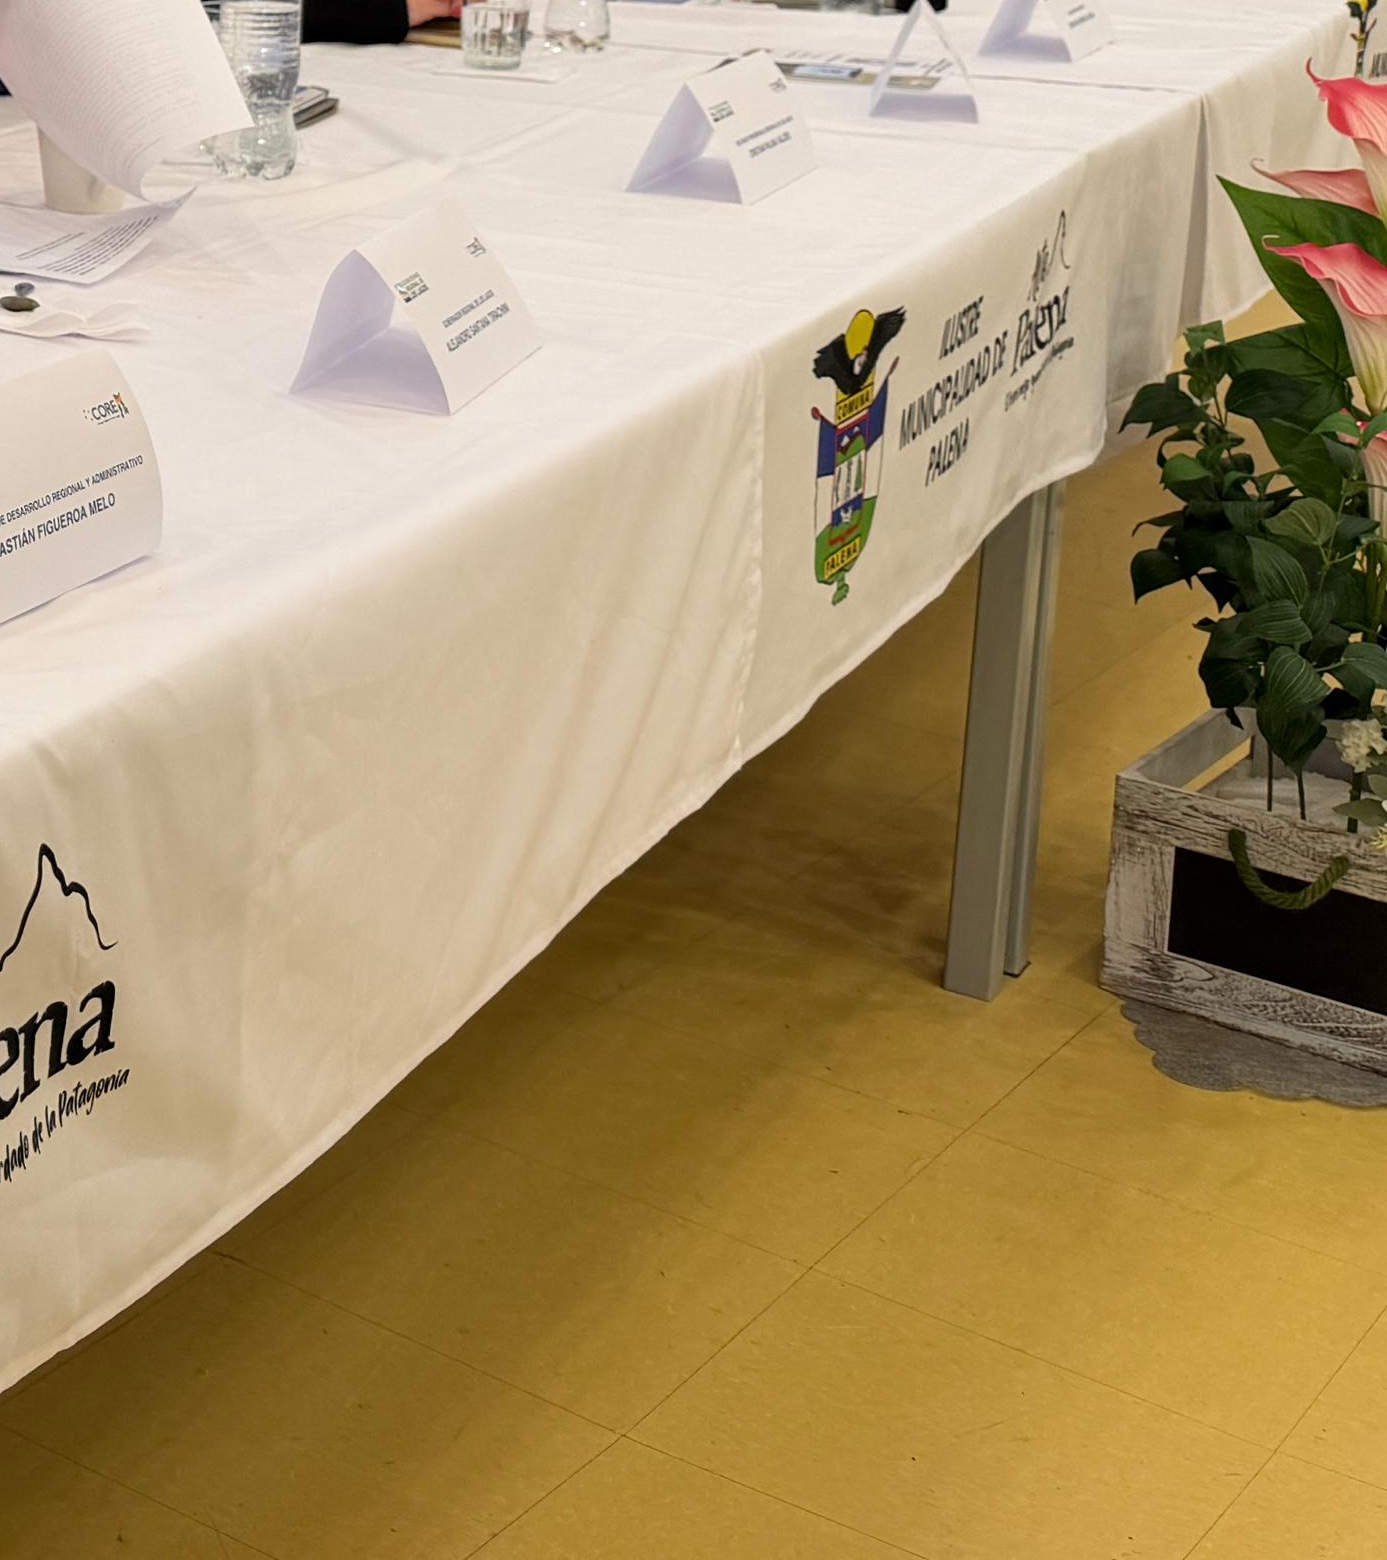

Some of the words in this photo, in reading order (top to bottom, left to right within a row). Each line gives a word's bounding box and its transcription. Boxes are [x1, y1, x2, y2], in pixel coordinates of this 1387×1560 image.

[91, 400, 118, 421] CORE
[6, 495, 51, 522] DESARROLLO
[52, 483, 85, 502] REGIONAL
[91, 455, 144, 485] ADMINISTRATIVO
[37, 506, 88, 539] FIGUEROA
[89, 493, 115, 516] MELO
[32, 1116, 43, 1154] de
[45, 1105, 56, 1137] la
[59, 1069, 129, 1127] Patagonia
